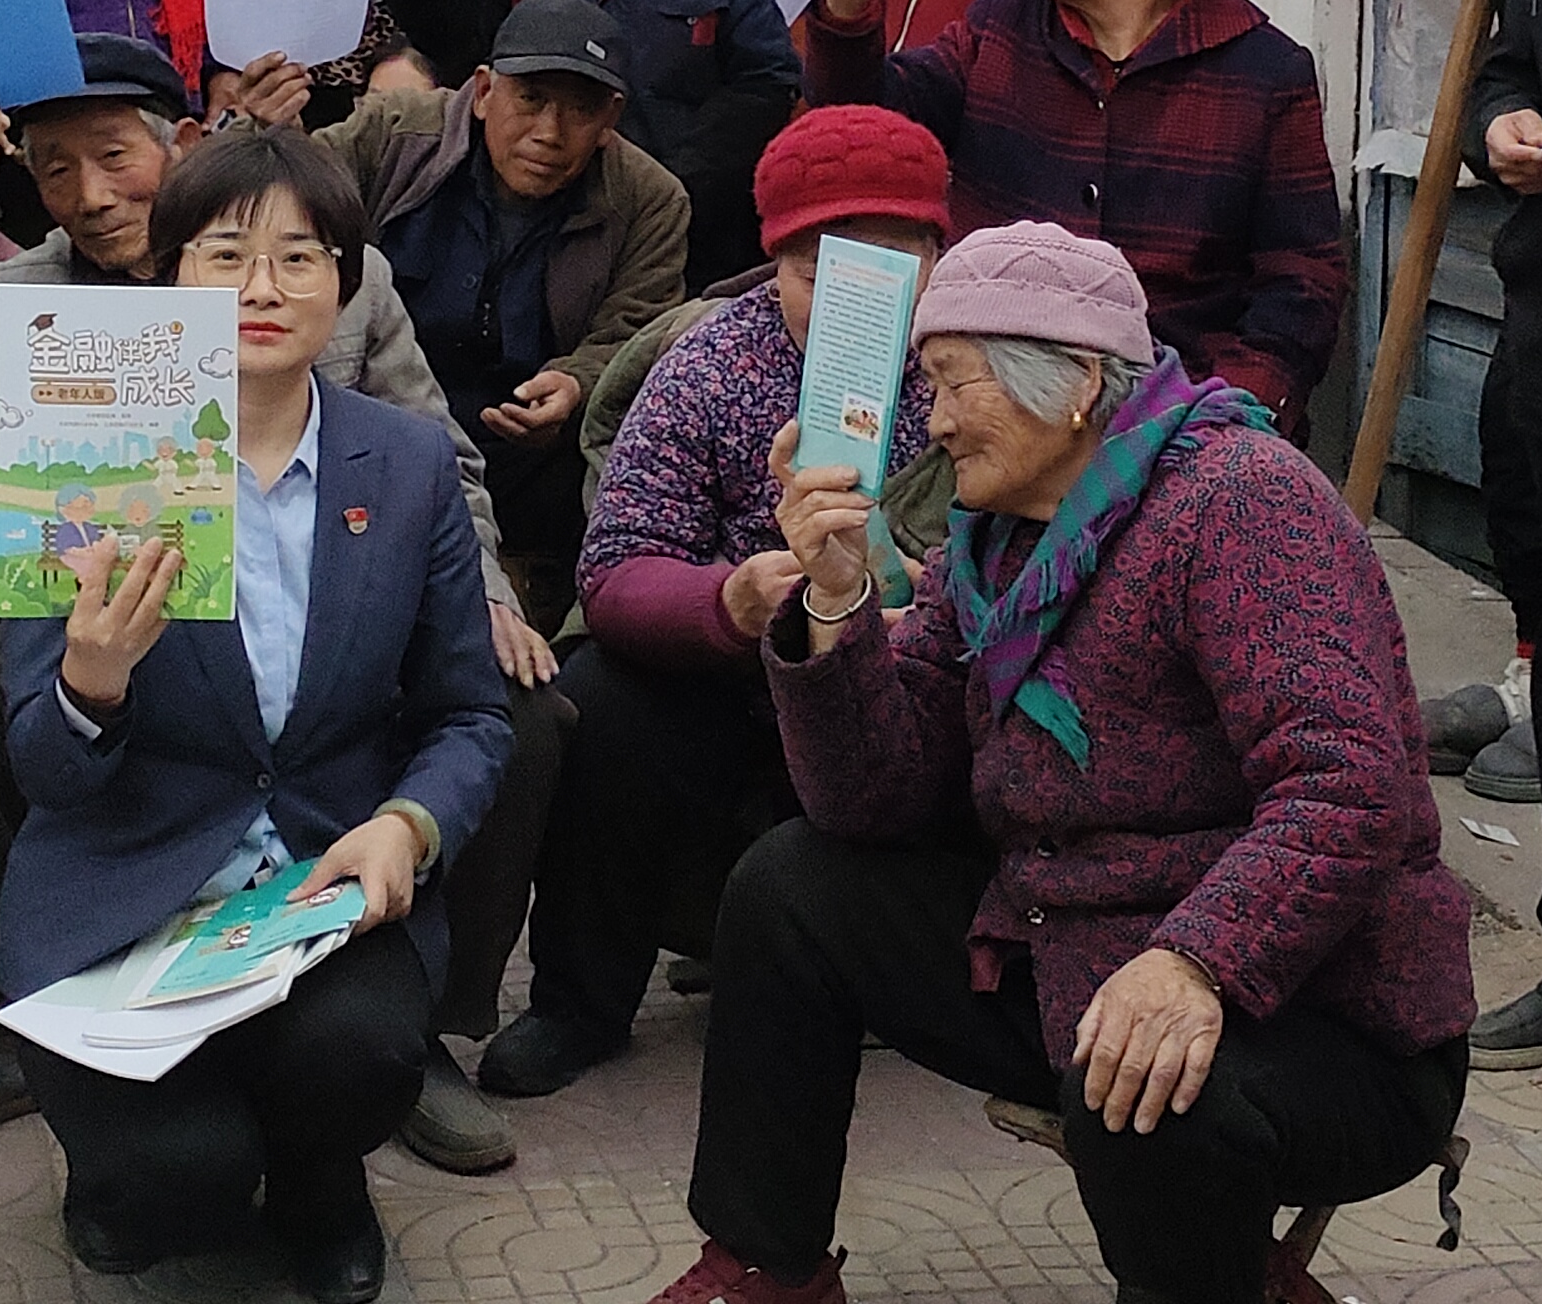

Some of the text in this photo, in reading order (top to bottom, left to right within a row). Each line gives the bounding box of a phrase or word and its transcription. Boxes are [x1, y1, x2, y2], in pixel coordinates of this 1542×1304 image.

[27, 322, 183, 374] 金融伴我
[120, 365, 196, 407] 成长
